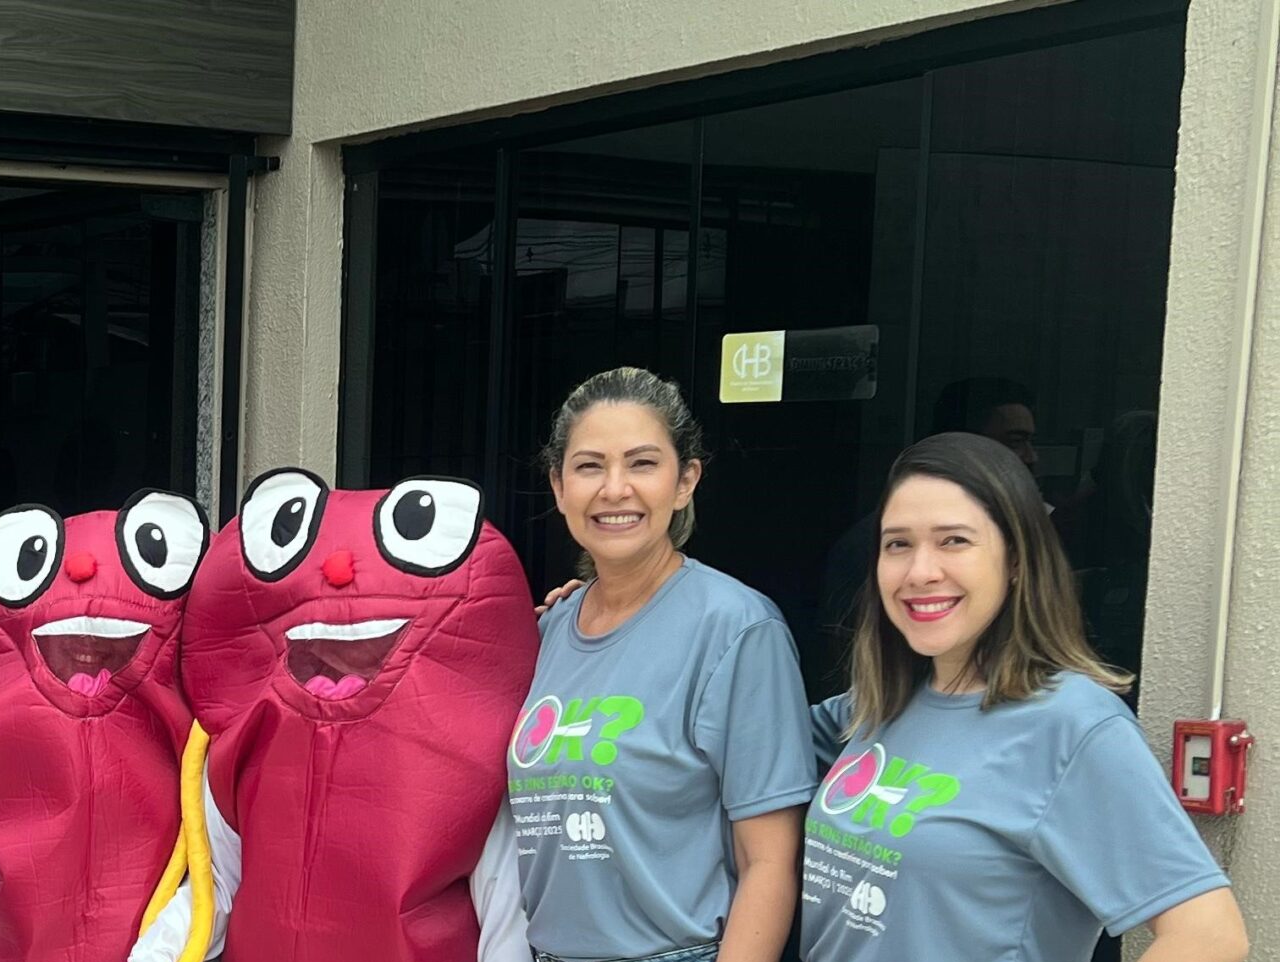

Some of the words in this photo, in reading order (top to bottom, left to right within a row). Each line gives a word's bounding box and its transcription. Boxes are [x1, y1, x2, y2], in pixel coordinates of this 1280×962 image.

[732, 342, 772, 379] CHB
[512, 695, 645, 768] OK?
[582, 775, 614, 793] OK?
[821, 743, 961, 838] OK?
